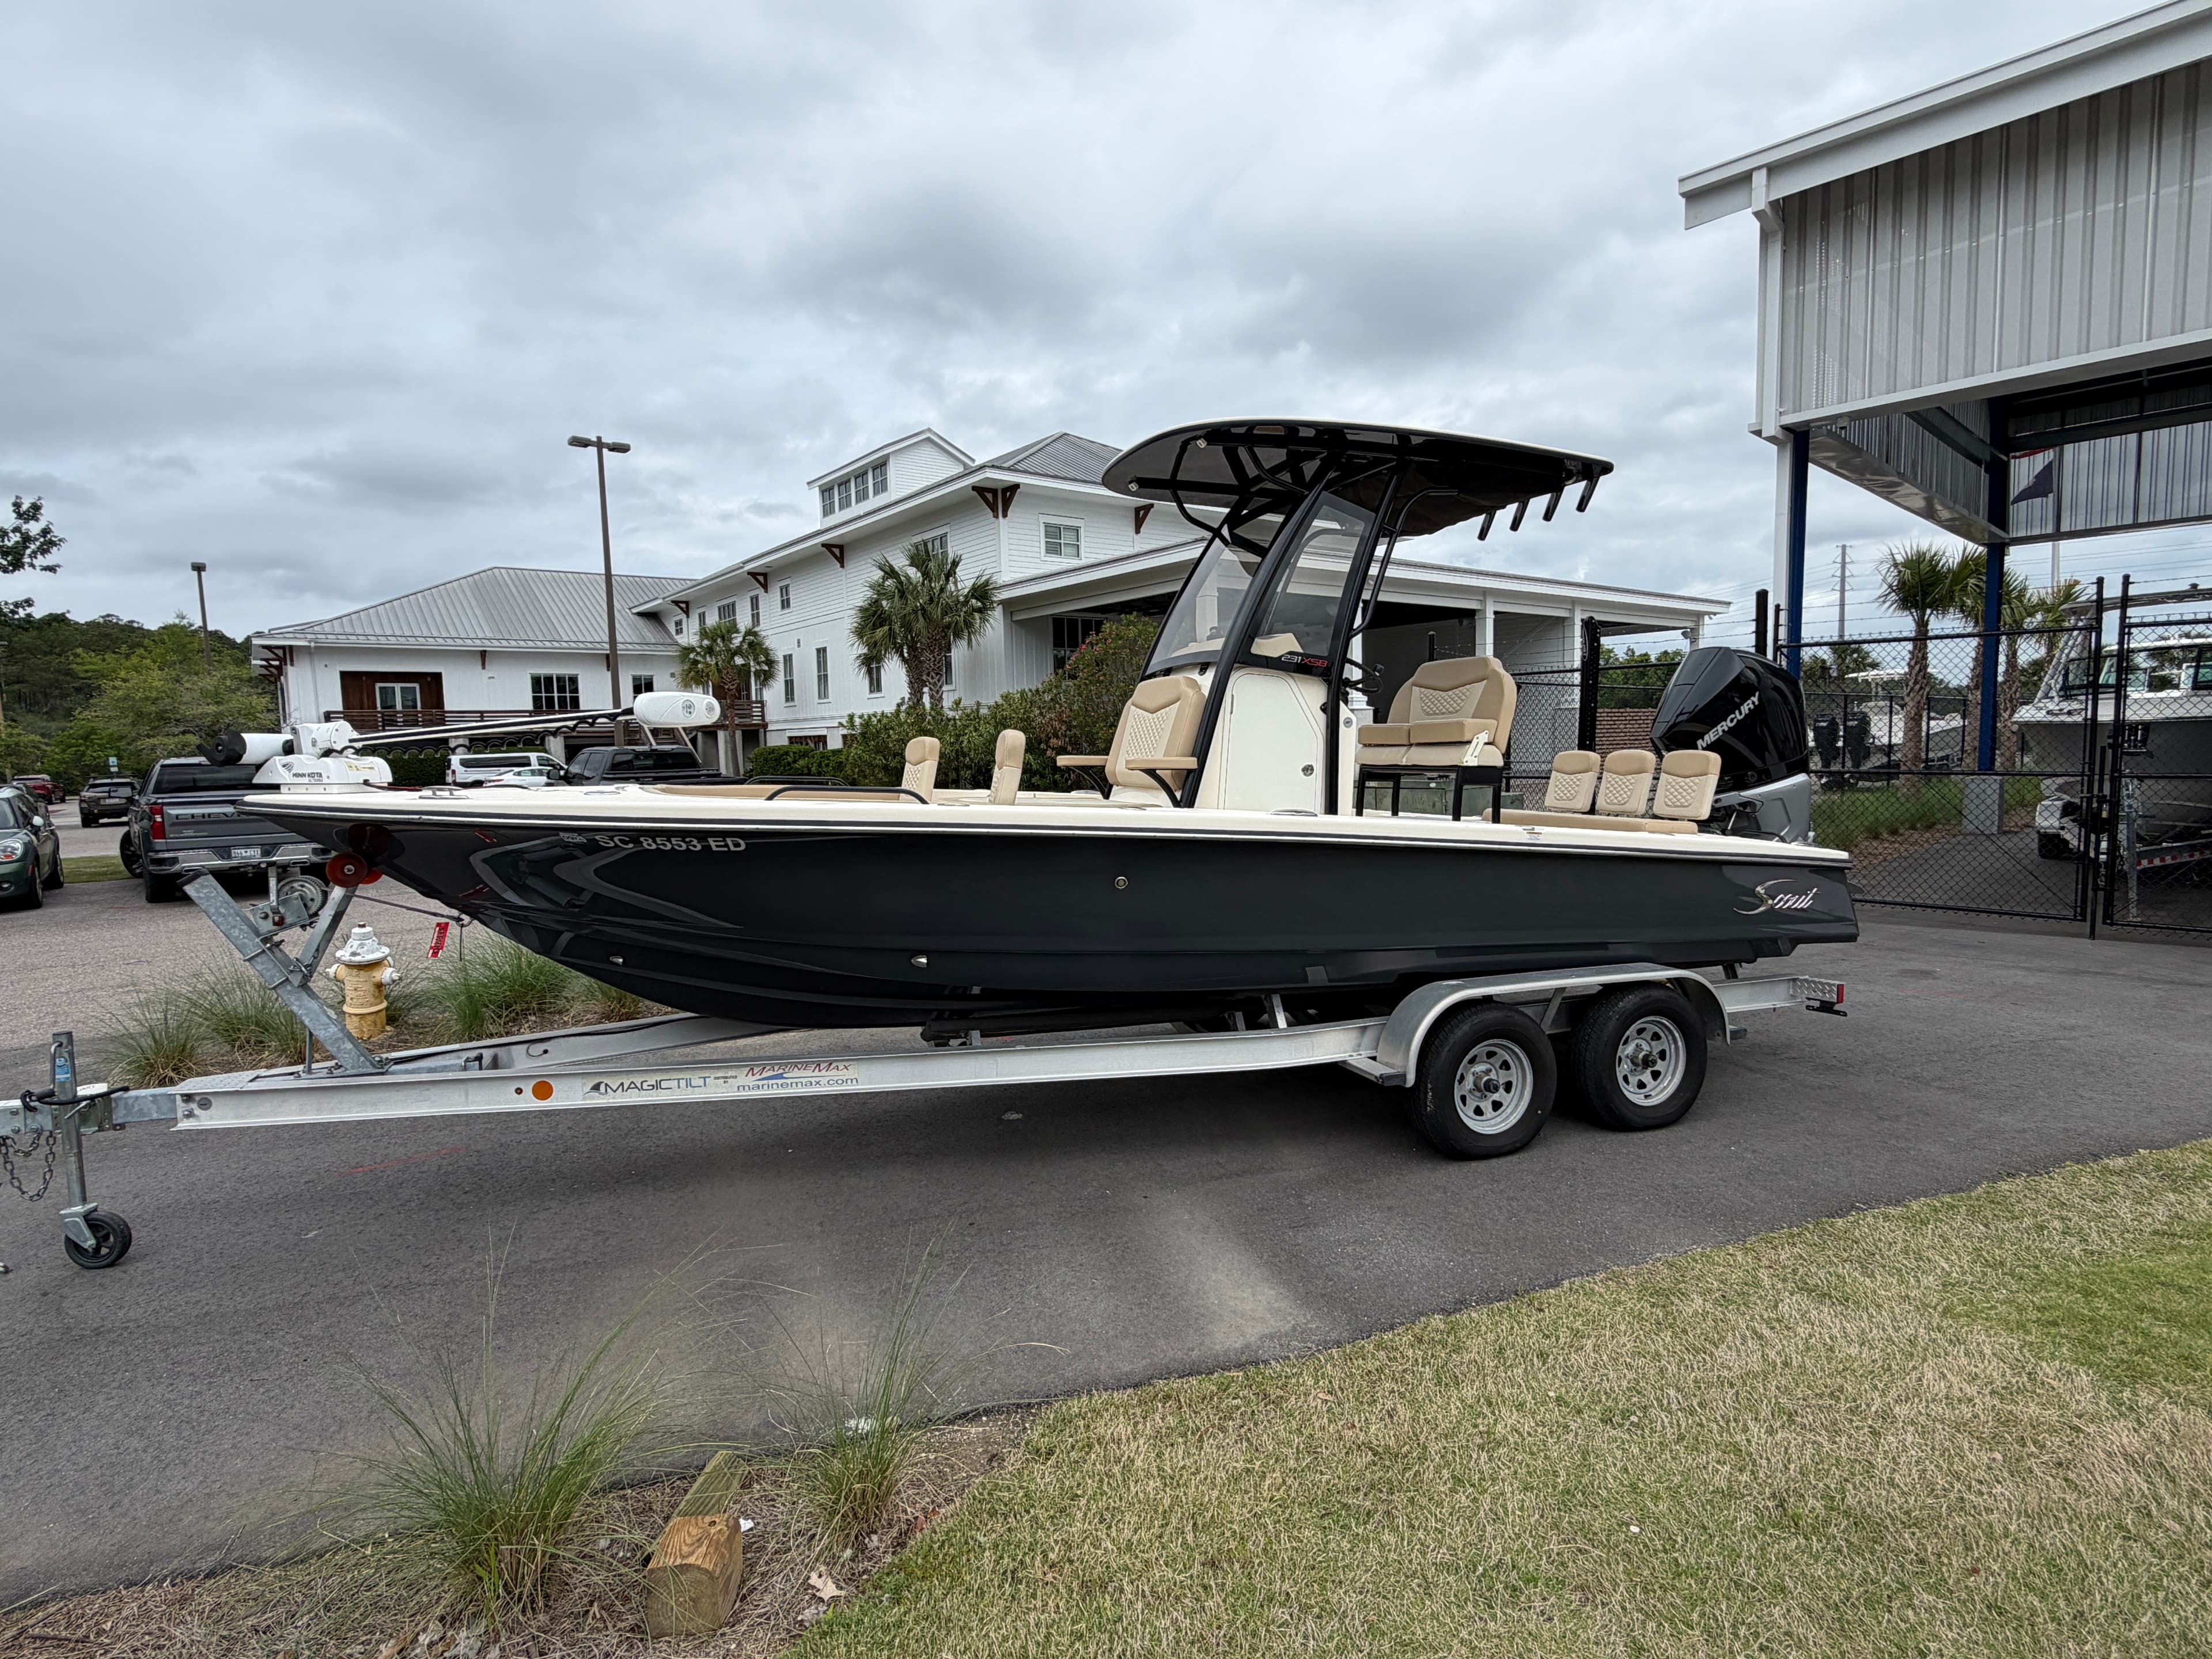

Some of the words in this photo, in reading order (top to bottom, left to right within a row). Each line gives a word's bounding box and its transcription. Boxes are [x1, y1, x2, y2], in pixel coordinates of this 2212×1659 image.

[1696, 691, 1760, 750] MERCURY
[594, 835, 634, 849] SC
[639, 836, 702, 851] 8553
[707, 837, 747, 851] ED
[1733, 878, 1821, 915] Scout
[737, 1077, 858, 1092] marinemax.com
